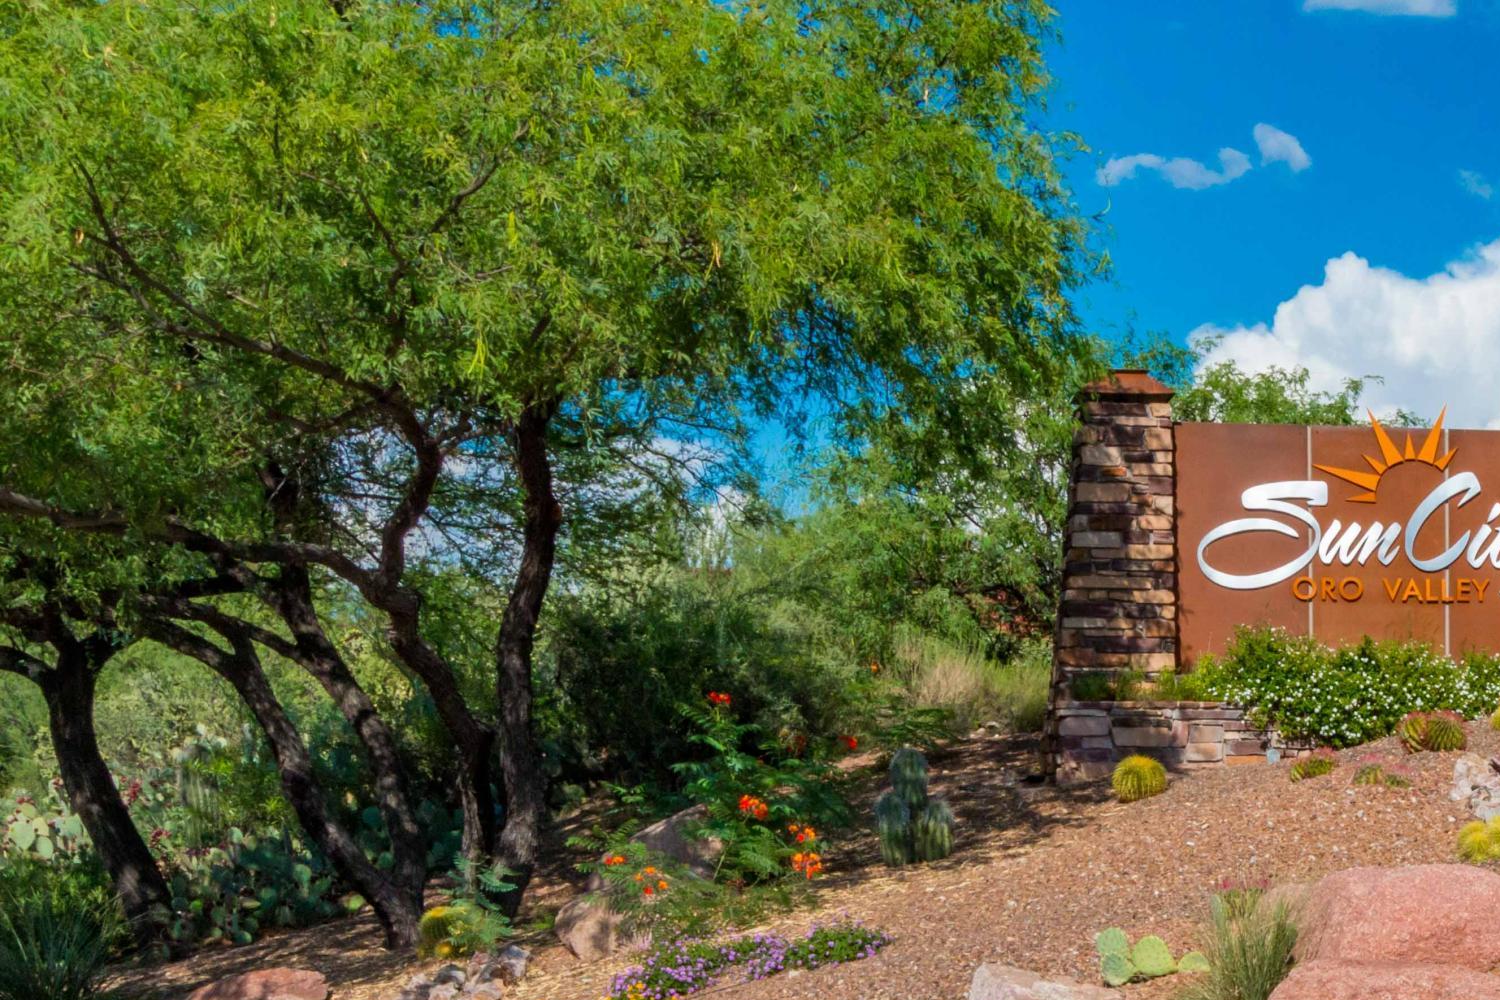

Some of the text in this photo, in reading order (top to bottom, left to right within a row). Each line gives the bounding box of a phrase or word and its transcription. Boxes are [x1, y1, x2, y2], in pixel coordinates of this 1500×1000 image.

[1197, 480, 1401, 590] Sun
[1292, 576, 1491, 603] ORO VALLEY
